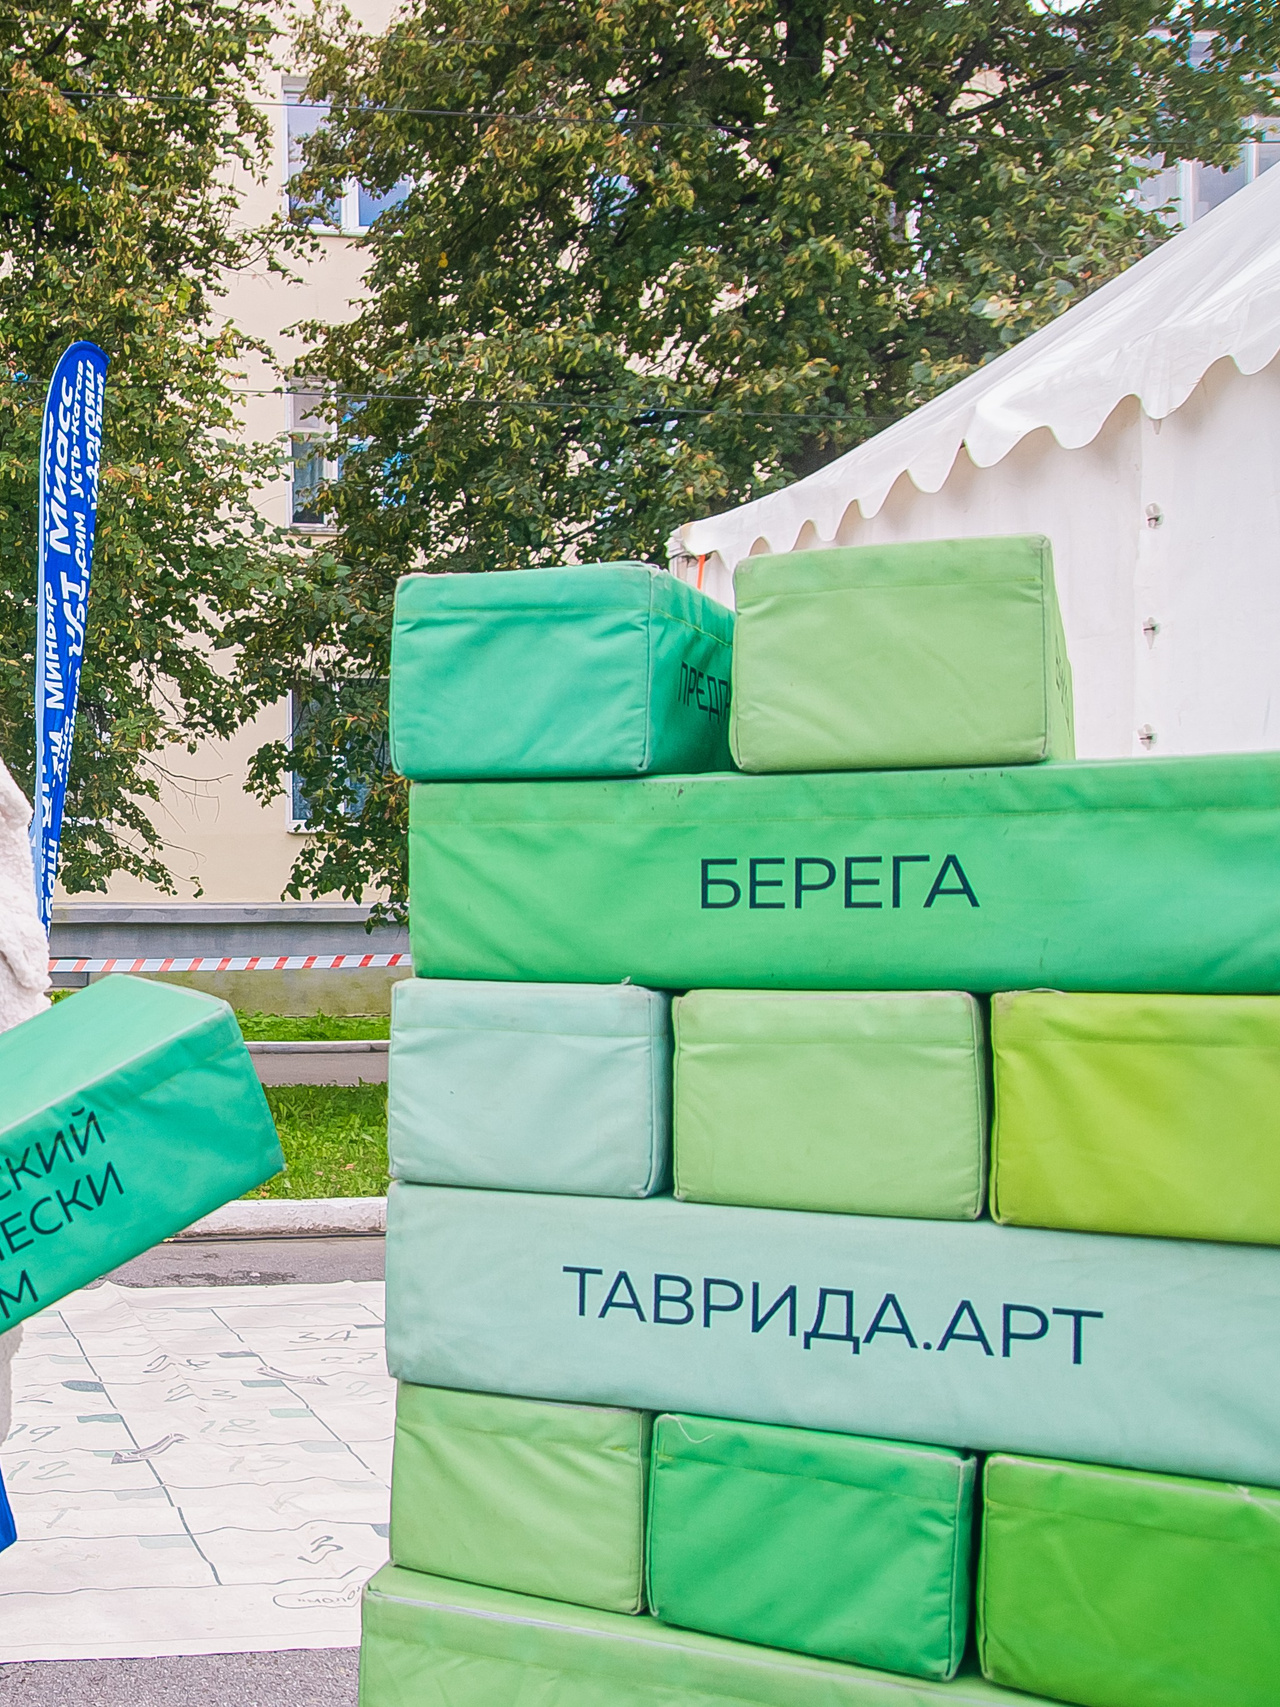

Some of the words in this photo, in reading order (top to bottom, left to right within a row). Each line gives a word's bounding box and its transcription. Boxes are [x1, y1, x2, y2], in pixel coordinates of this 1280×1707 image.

[49, 376, 73, 555] Миасс
[43, 581, 65, 710] Миньяр
[700, 853, 981, 911] БЕРЕГА
[562, 1265, 1105, 1366] ТАВРИДА.АРТ
